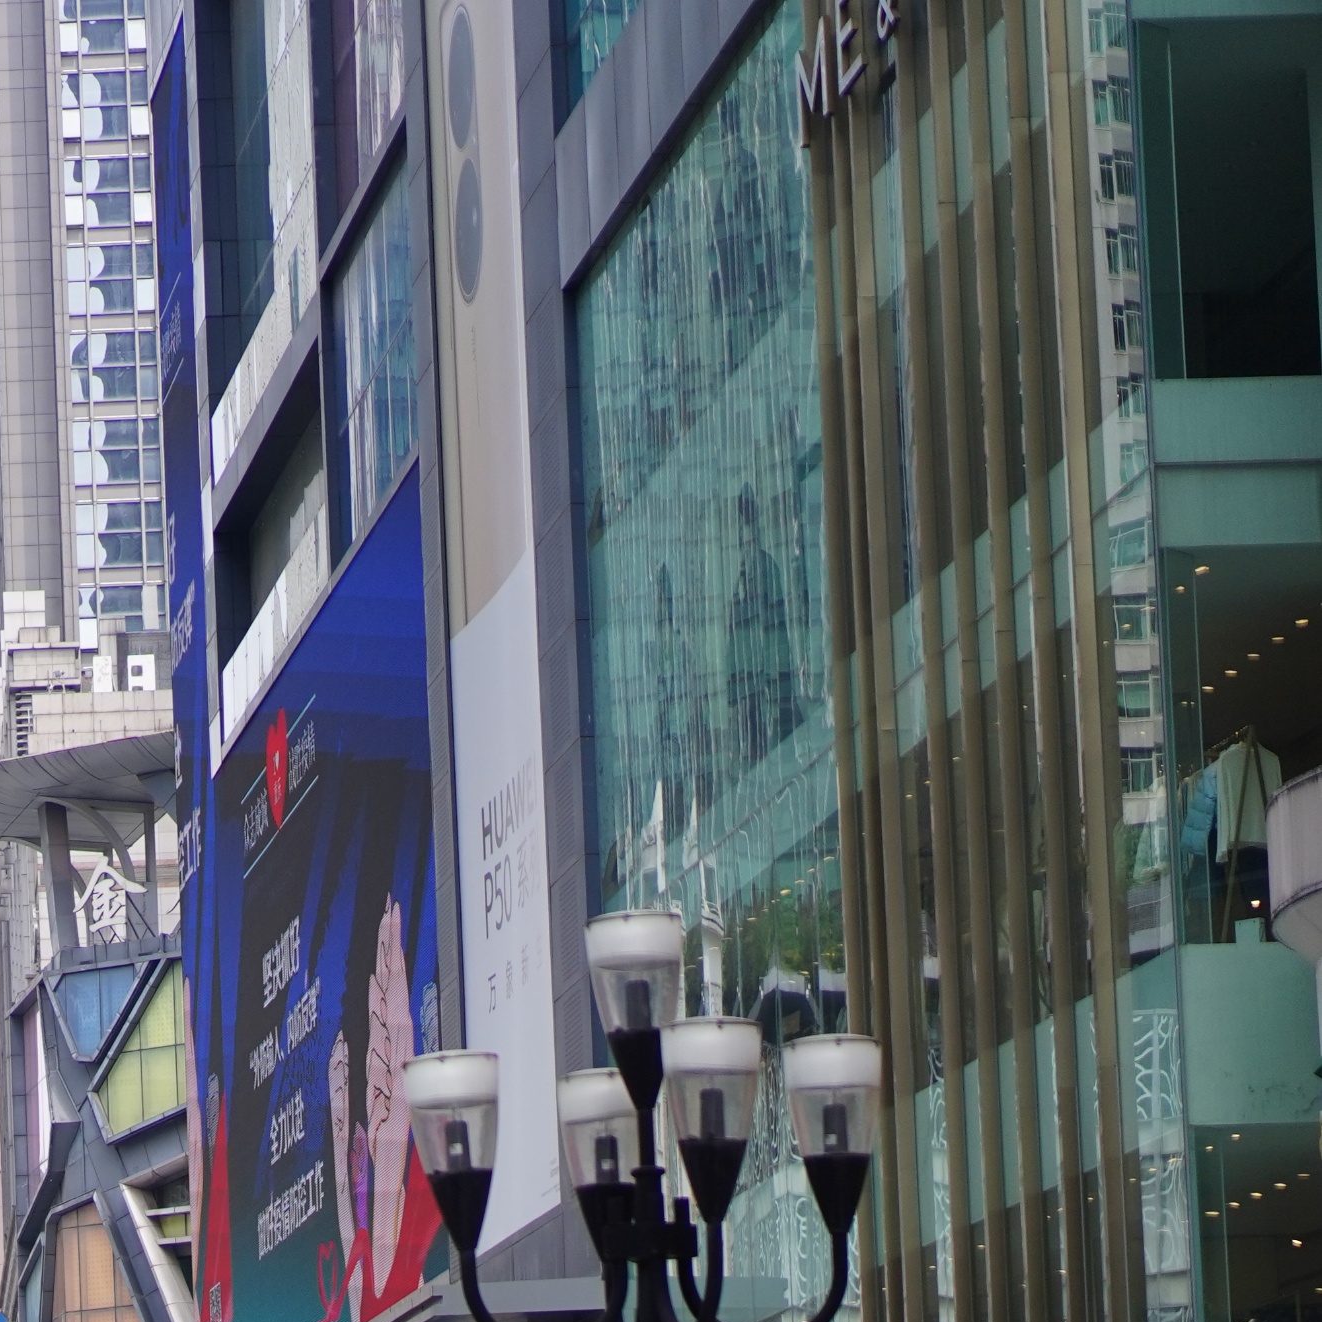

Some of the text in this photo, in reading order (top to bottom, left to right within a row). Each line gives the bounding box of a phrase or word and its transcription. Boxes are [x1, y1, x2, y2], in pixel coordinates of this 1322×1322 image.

[481, 755, 538, 862] HUAWEI
[73, 855, 149, 933] 金
[484, 853, 513, 940] P50
